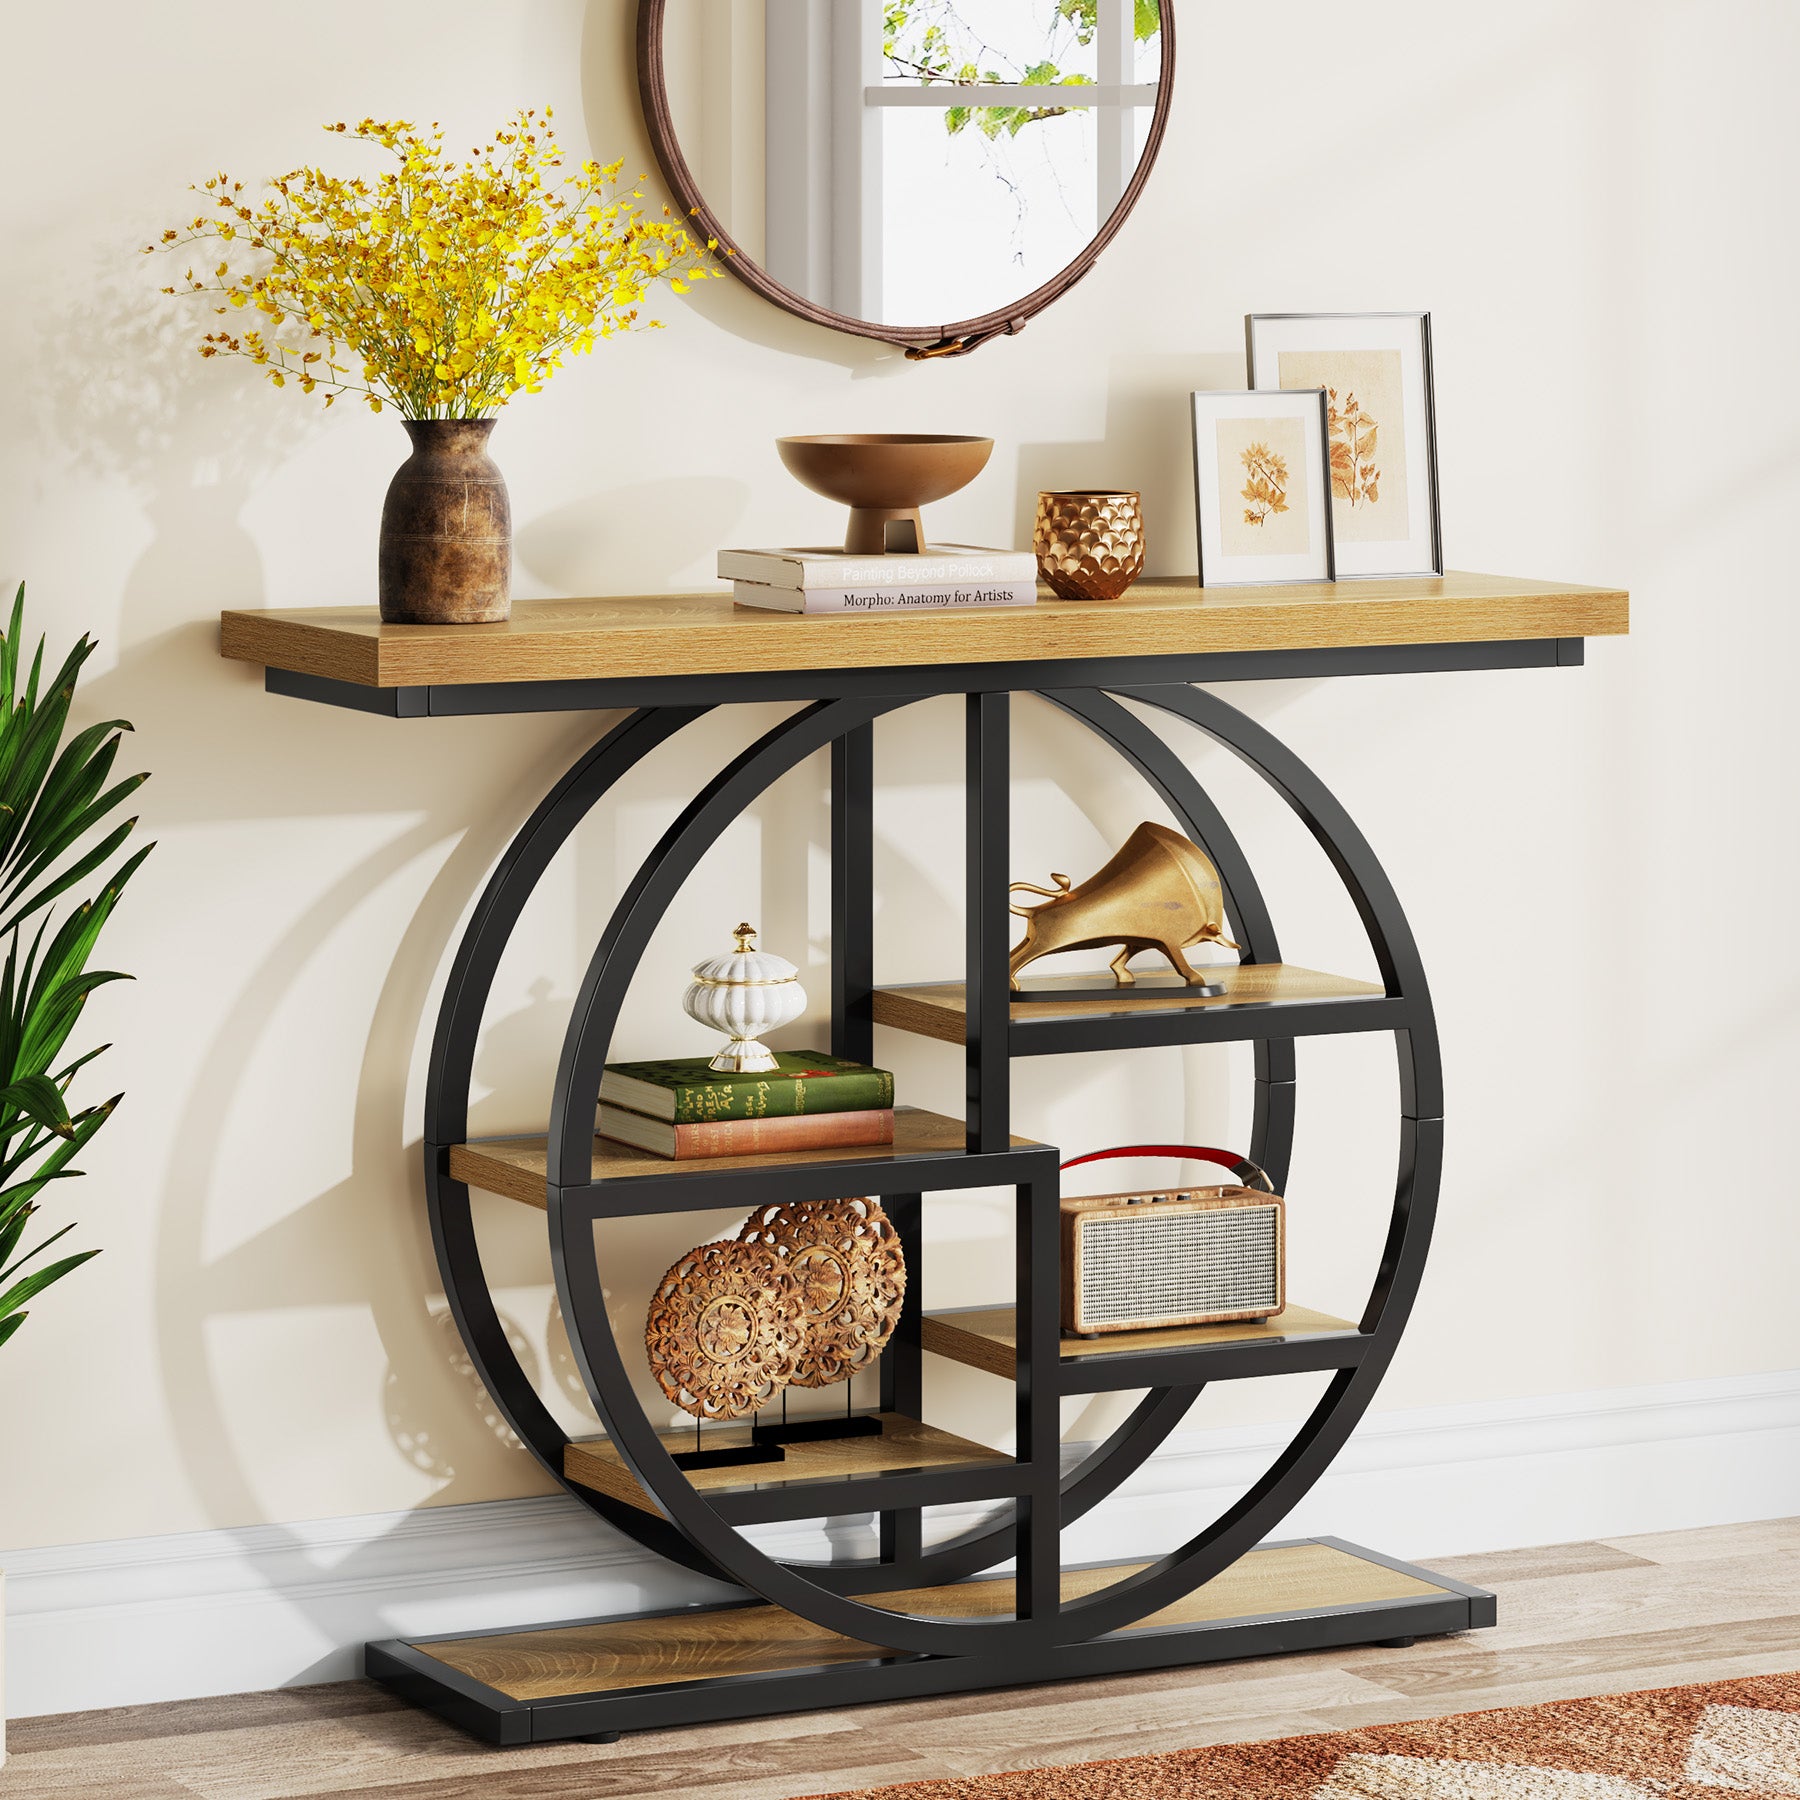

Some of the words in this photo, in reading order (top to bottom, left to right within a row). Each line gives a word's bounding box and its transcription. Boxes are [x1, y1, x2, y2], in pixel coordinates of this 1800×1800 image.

[842, 567, 894, 584] Painting
[897, 564, 945, 583] Beyond
[949, 563, 994, 578] Pollock
[844, 593, 895, 609] Morpho:
[897, 592, 951, 607] Anatomy
[954, 590, 971, 603] for
[974, 589, 1014, 602] Artists
[696, 1094, 704, 1115] AND
